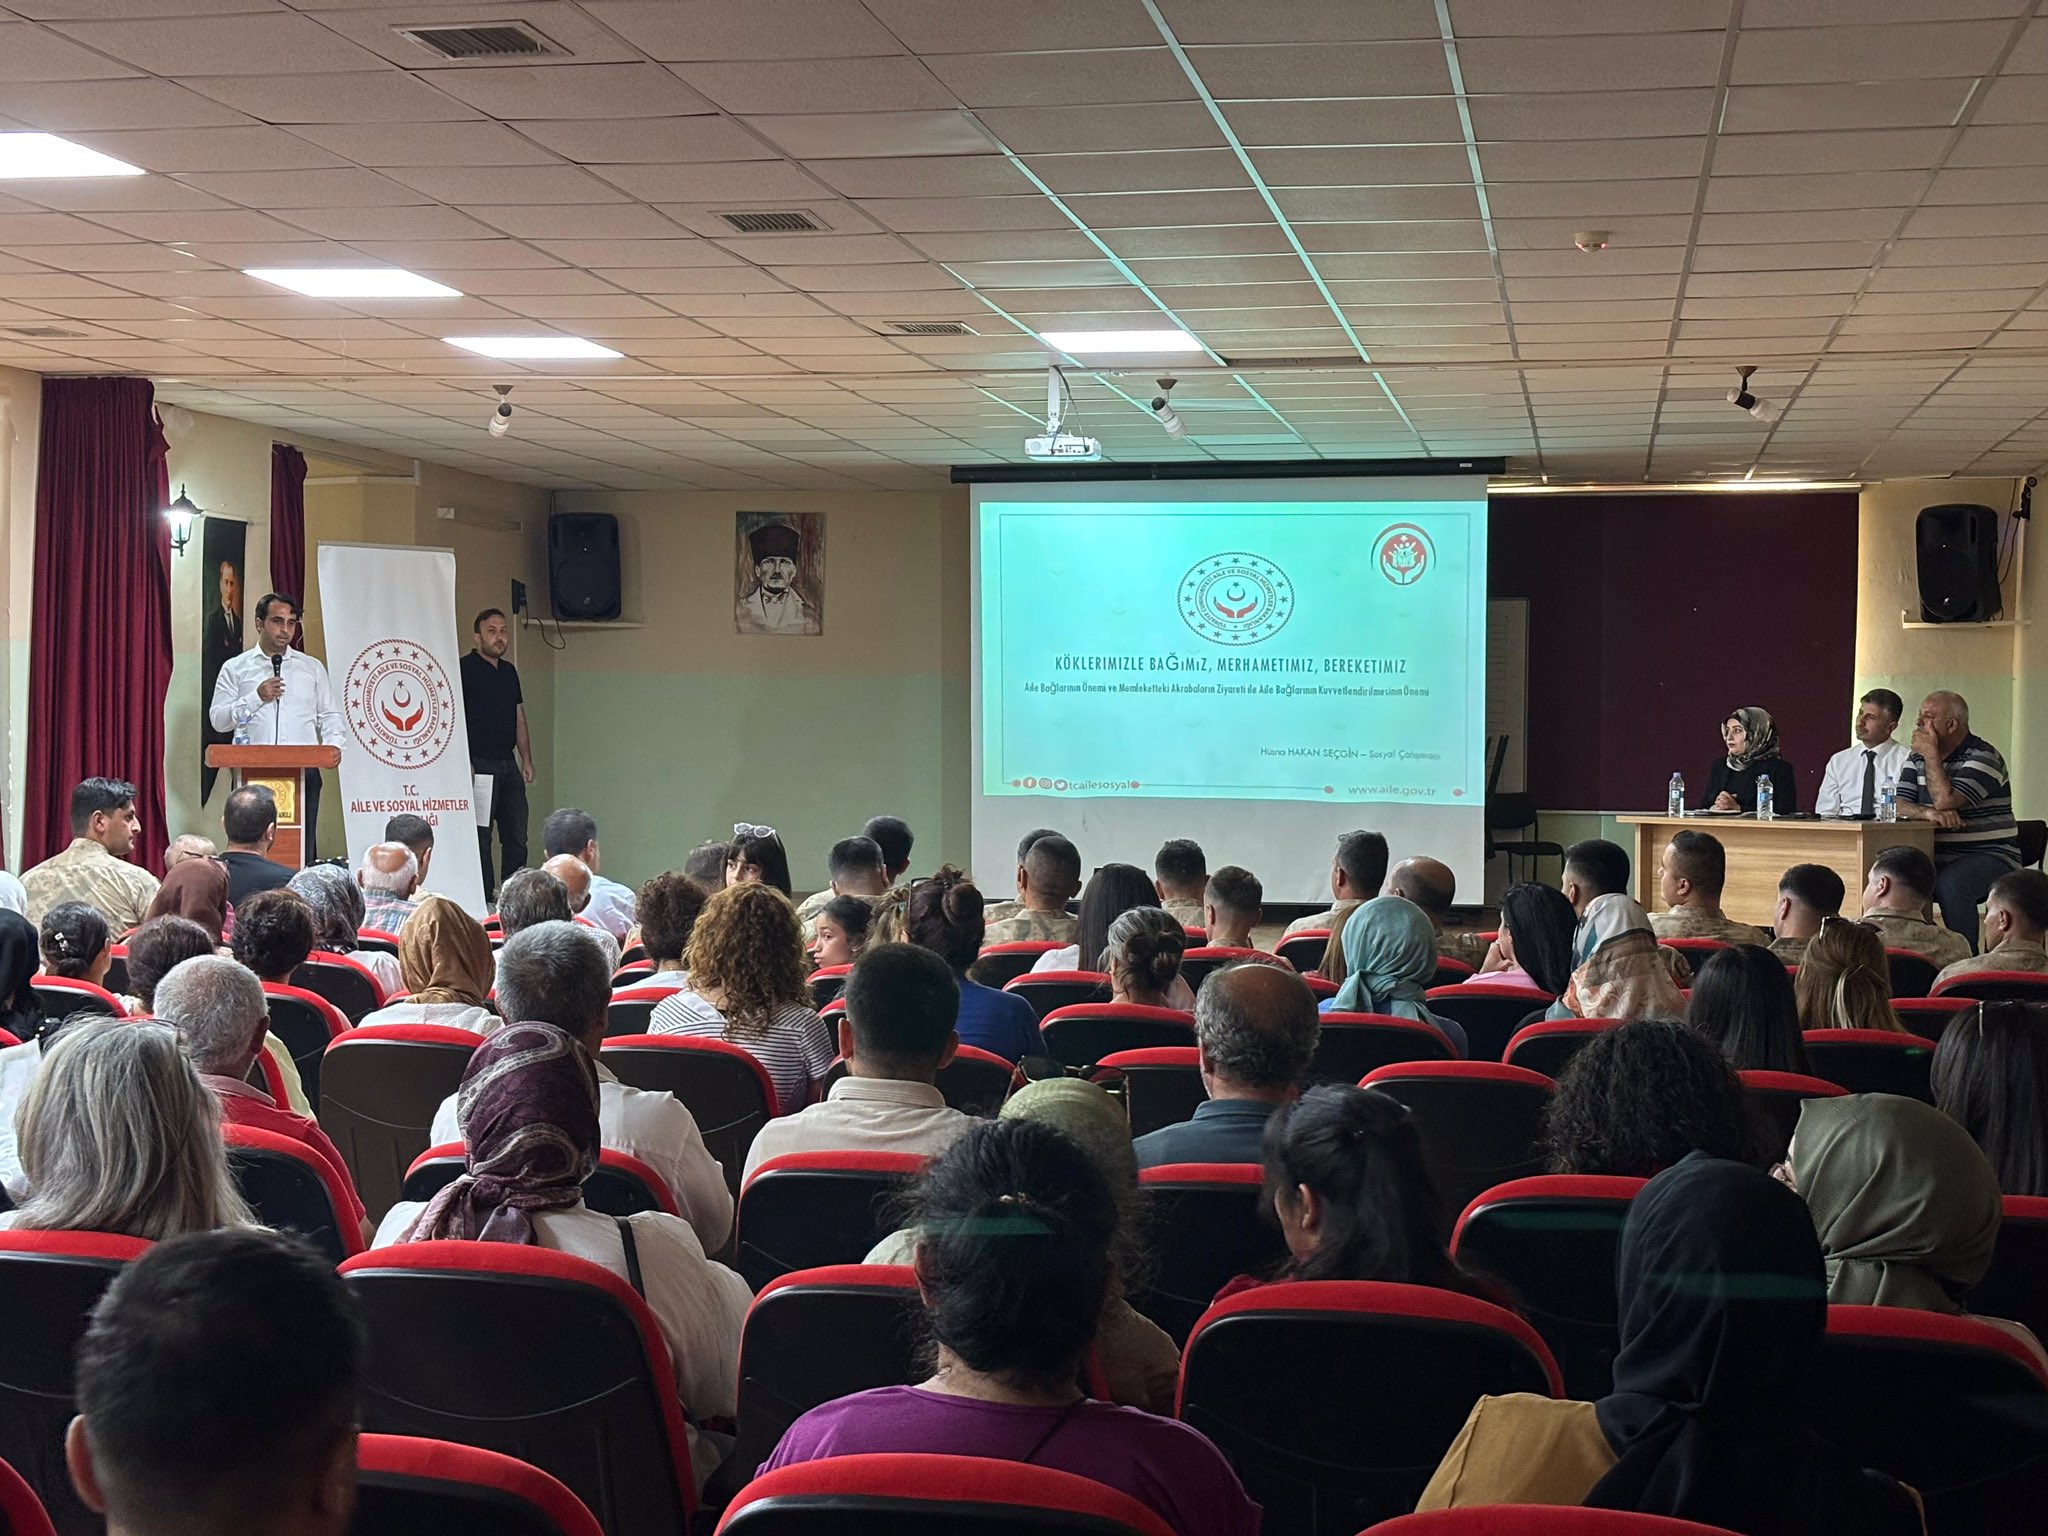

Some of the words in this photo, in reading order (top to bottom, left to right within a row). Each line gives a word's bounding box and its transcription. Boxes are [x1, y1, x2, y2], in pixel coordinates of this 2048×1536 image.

[399, 662, 422, 679] SOSYAL
[1288, 747, 1321, 757] HAKAN
[1369, 750, 1396, 760] Sosyal
[402, 784, 420, 797] T.C.
[1069, 780, 1131, 791] tcailesosyal
[1349, 785, 1437, 797] www.aile.gov.tr
[351, 798, 372, 812] AİLE
[373, 800, 386, 812] VE
[387, 799, 421, 812] SOSYAL
[422, 797, 469, 811] HİZMETLER
